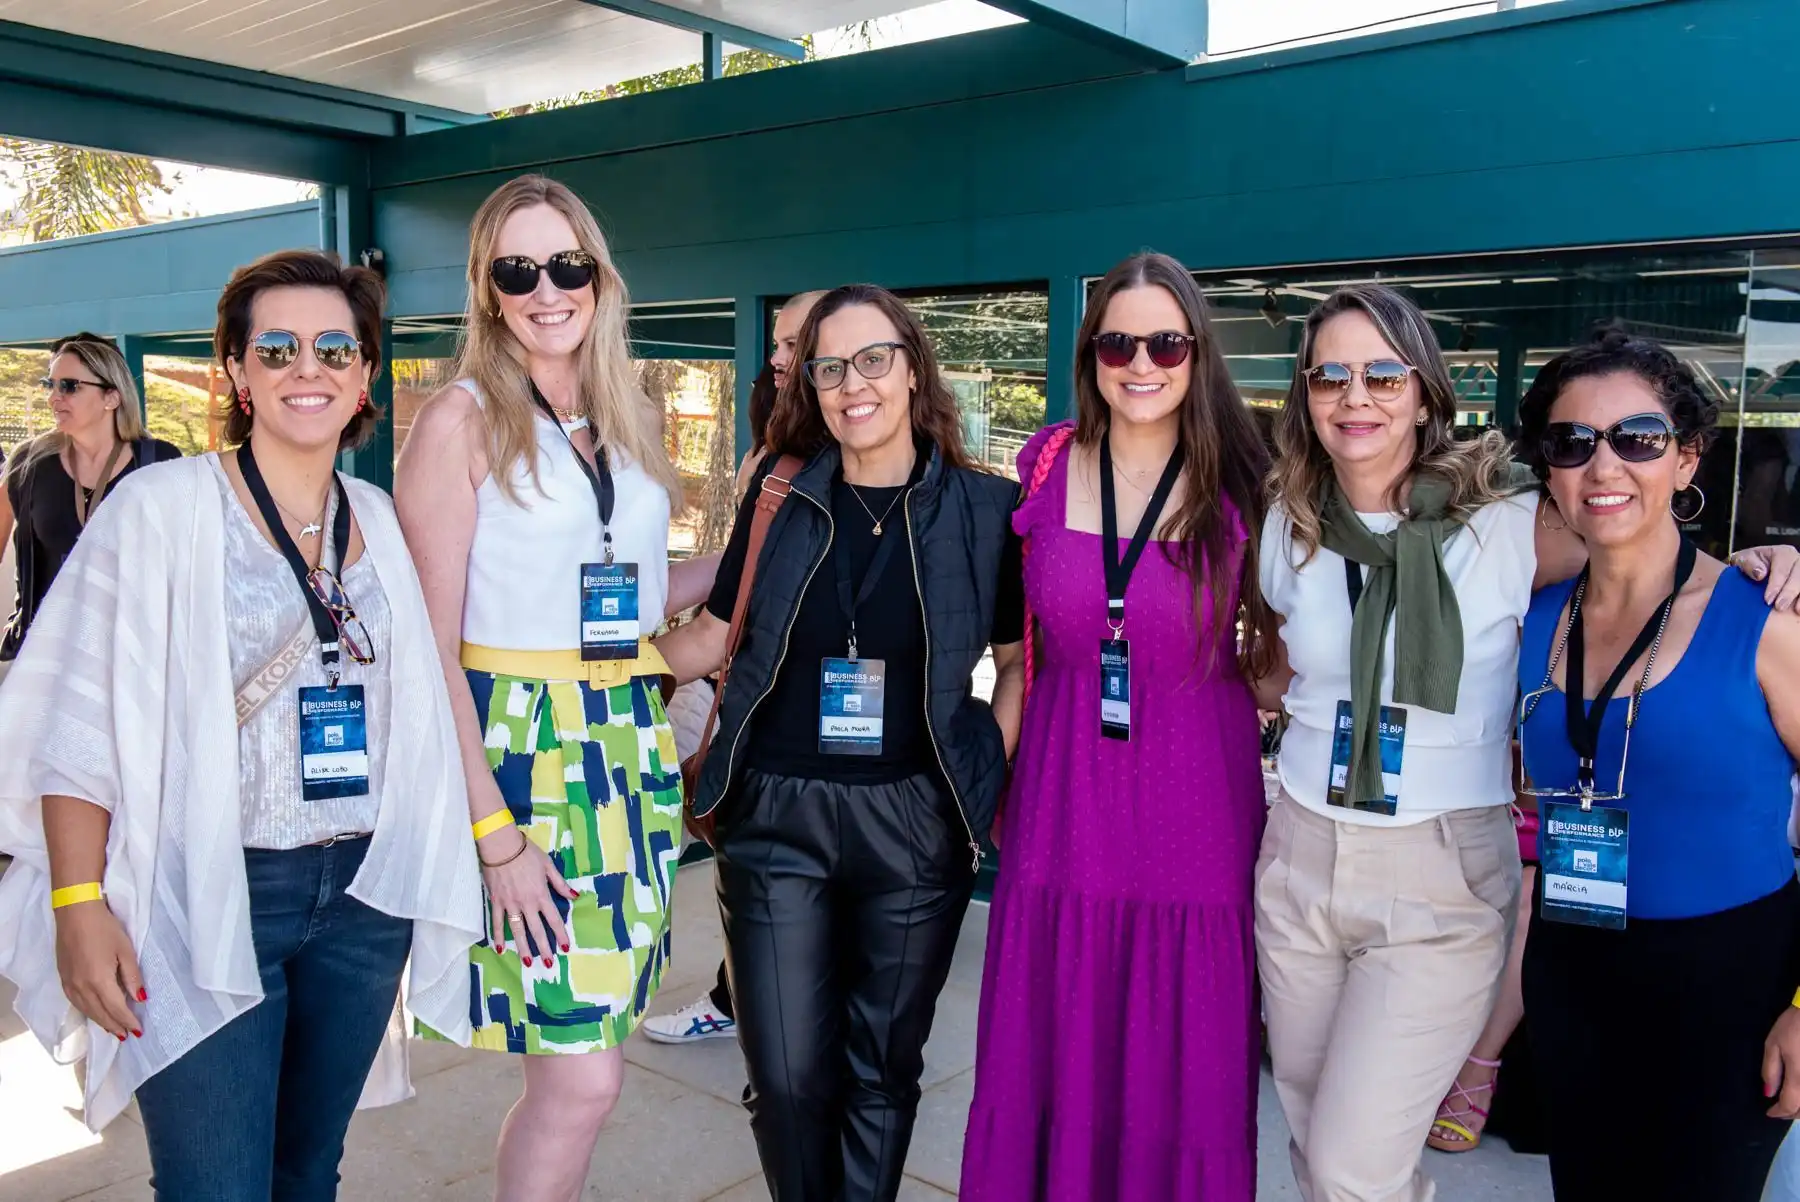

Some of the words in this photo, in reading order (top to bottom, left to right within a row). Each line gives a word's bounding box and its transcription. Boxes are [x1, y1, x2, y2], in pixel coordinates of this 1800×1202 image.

[255, 636, 307, 694] KORS
[310, 700, 348, 709] BUSINESS
[1558, 821, 1605, 834] BUSINESS
[1558, 829, 1605, 838] PERFORMANCE
